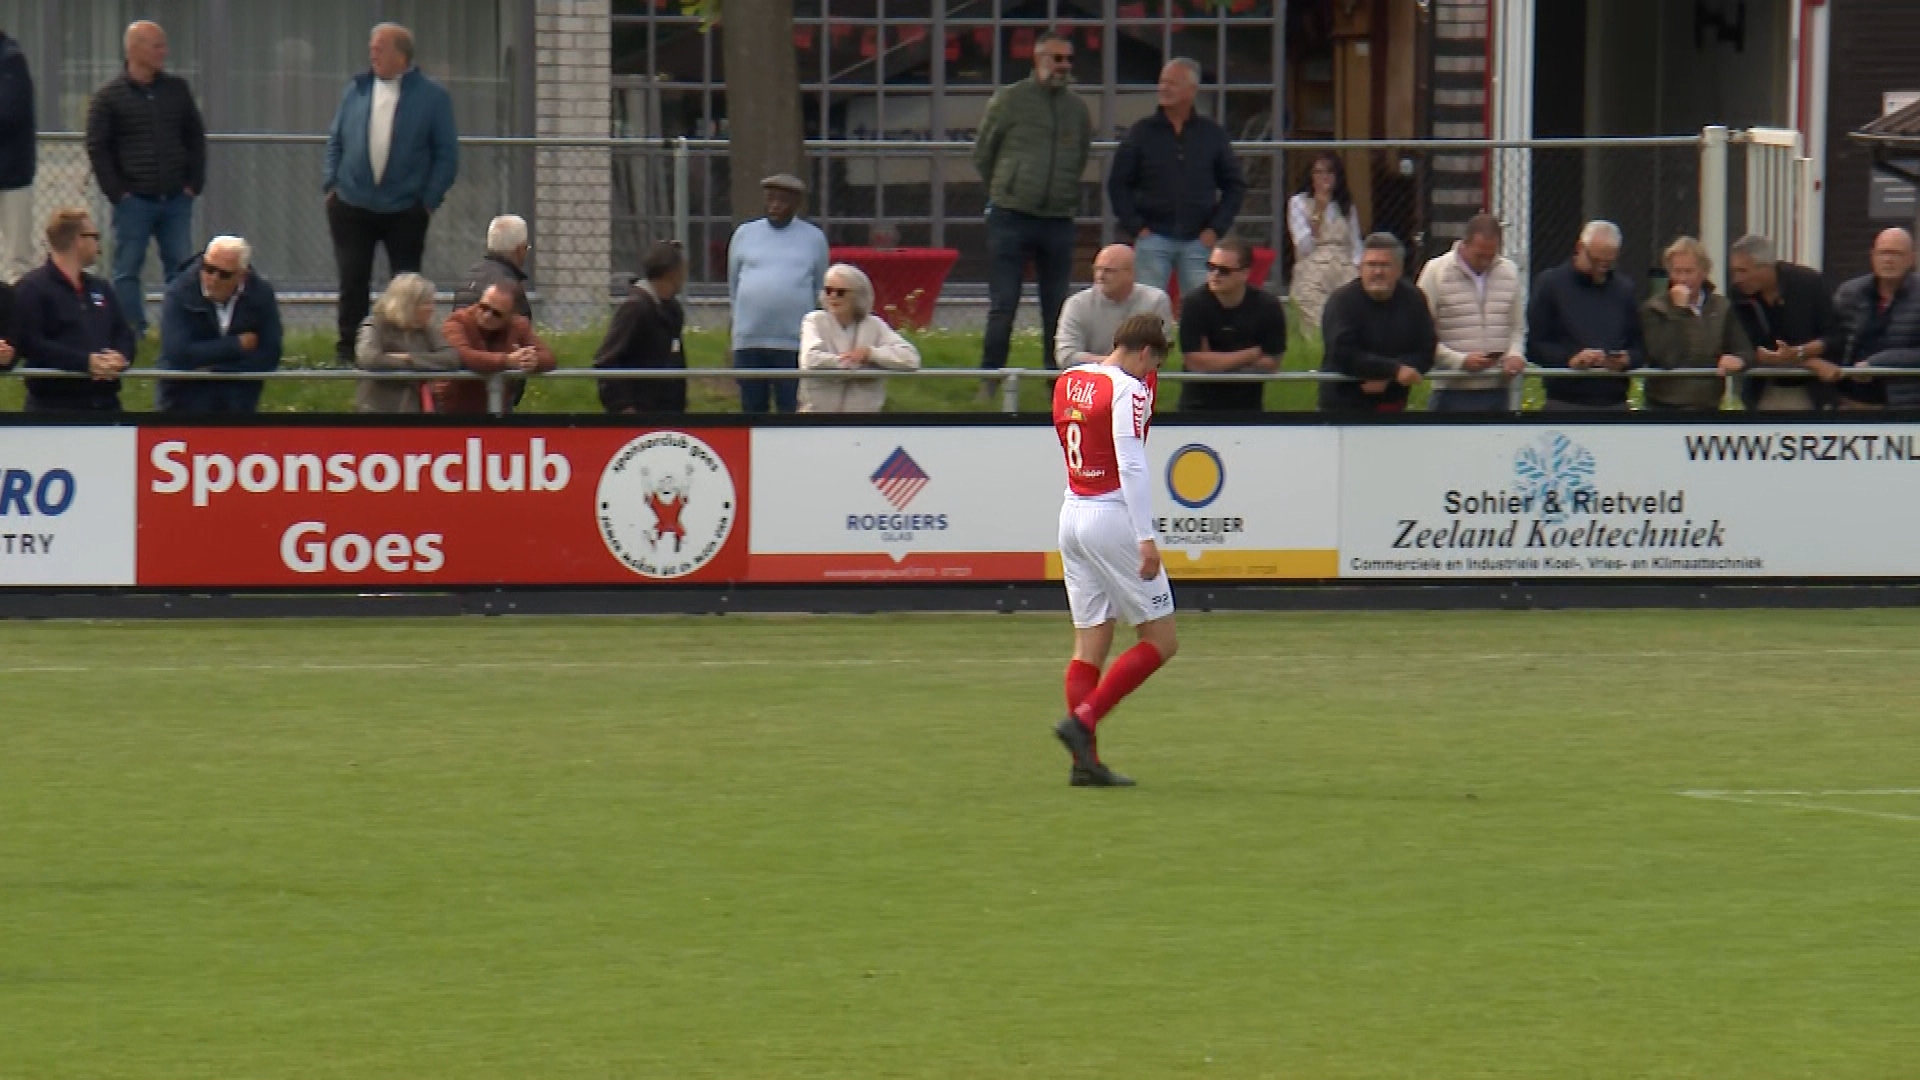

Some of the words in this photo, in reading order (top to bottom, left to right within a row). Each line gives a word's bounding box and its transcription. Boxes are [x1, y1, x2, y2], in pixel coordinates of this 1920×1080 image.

[1066, 377, 1098, 405] Valk
[1066, 422, 1083, 469] 8
[1685, 435, 1920, 461] WWW.SRZKT.NL
[150, 437, 572, 507] Sponsorclub
[0, 468, 76, 516] RO
[1444, 490, 1535, 515] Sohier
[1542, 490, 1562, 515] &
[1573, 490, 1685, 515] Rietveld
[846, 513, 949, 531] ROEGIERS
[1392, 519, 1518, 549] Zeeland
[1524, 519, 1726, 549] Koeltechniek
[0, 533, 55, 554] TRY
[280, 521, 446, 573] Goes
